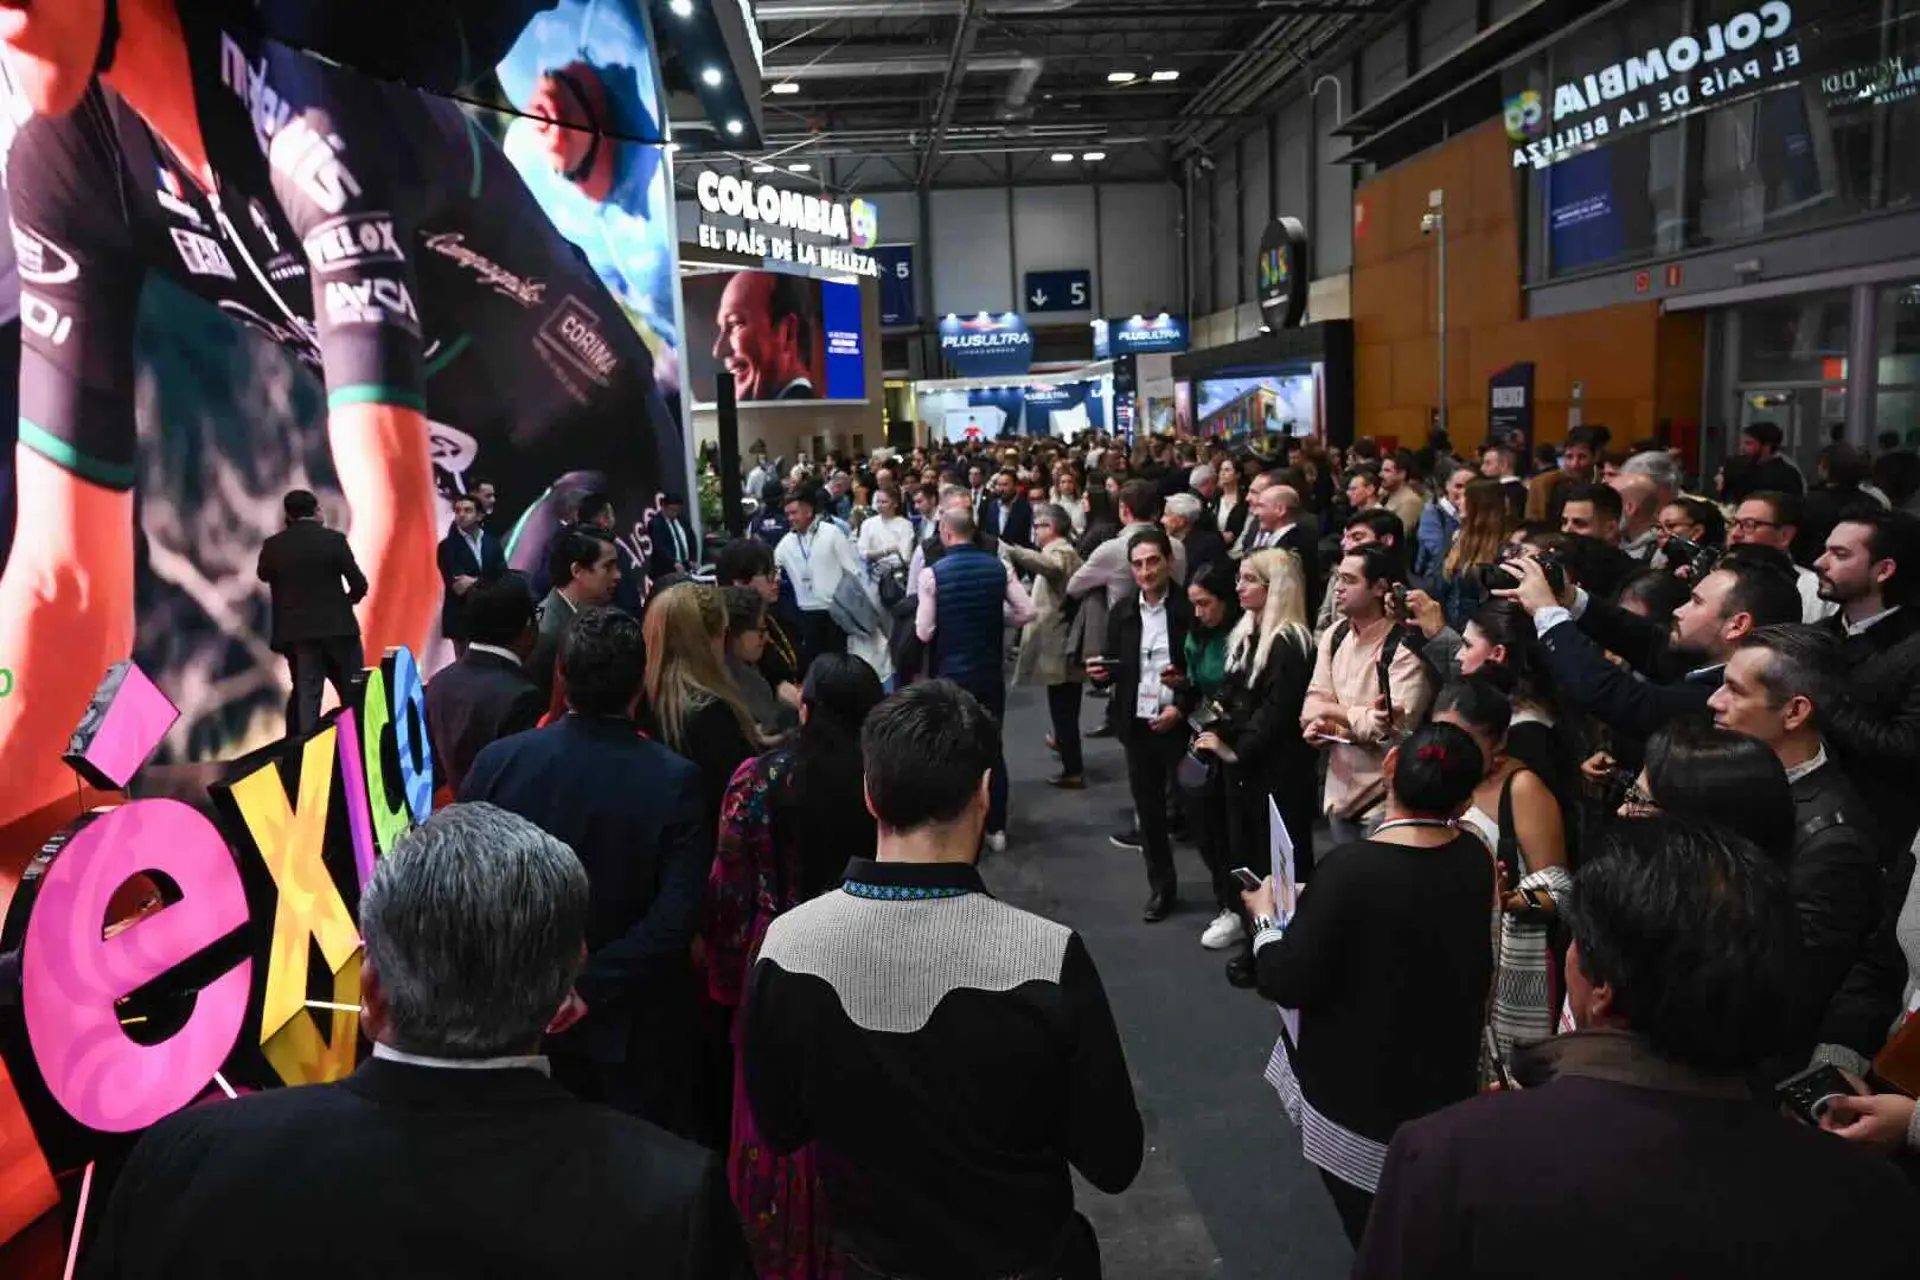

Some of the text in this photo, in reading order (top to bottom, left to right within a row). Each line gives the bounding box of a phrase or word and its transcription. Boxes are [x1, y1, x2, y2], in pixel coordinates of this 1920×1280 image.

[697, 170, 849, 240] COLOMBIA
[699, 224, 878, 277] EL PAÍS DE LA BELLEZA
[896, 262, 910, 279] 5
[1070, 282, 1086, 305] 5
[0, 645, 434, 1245] éxico
